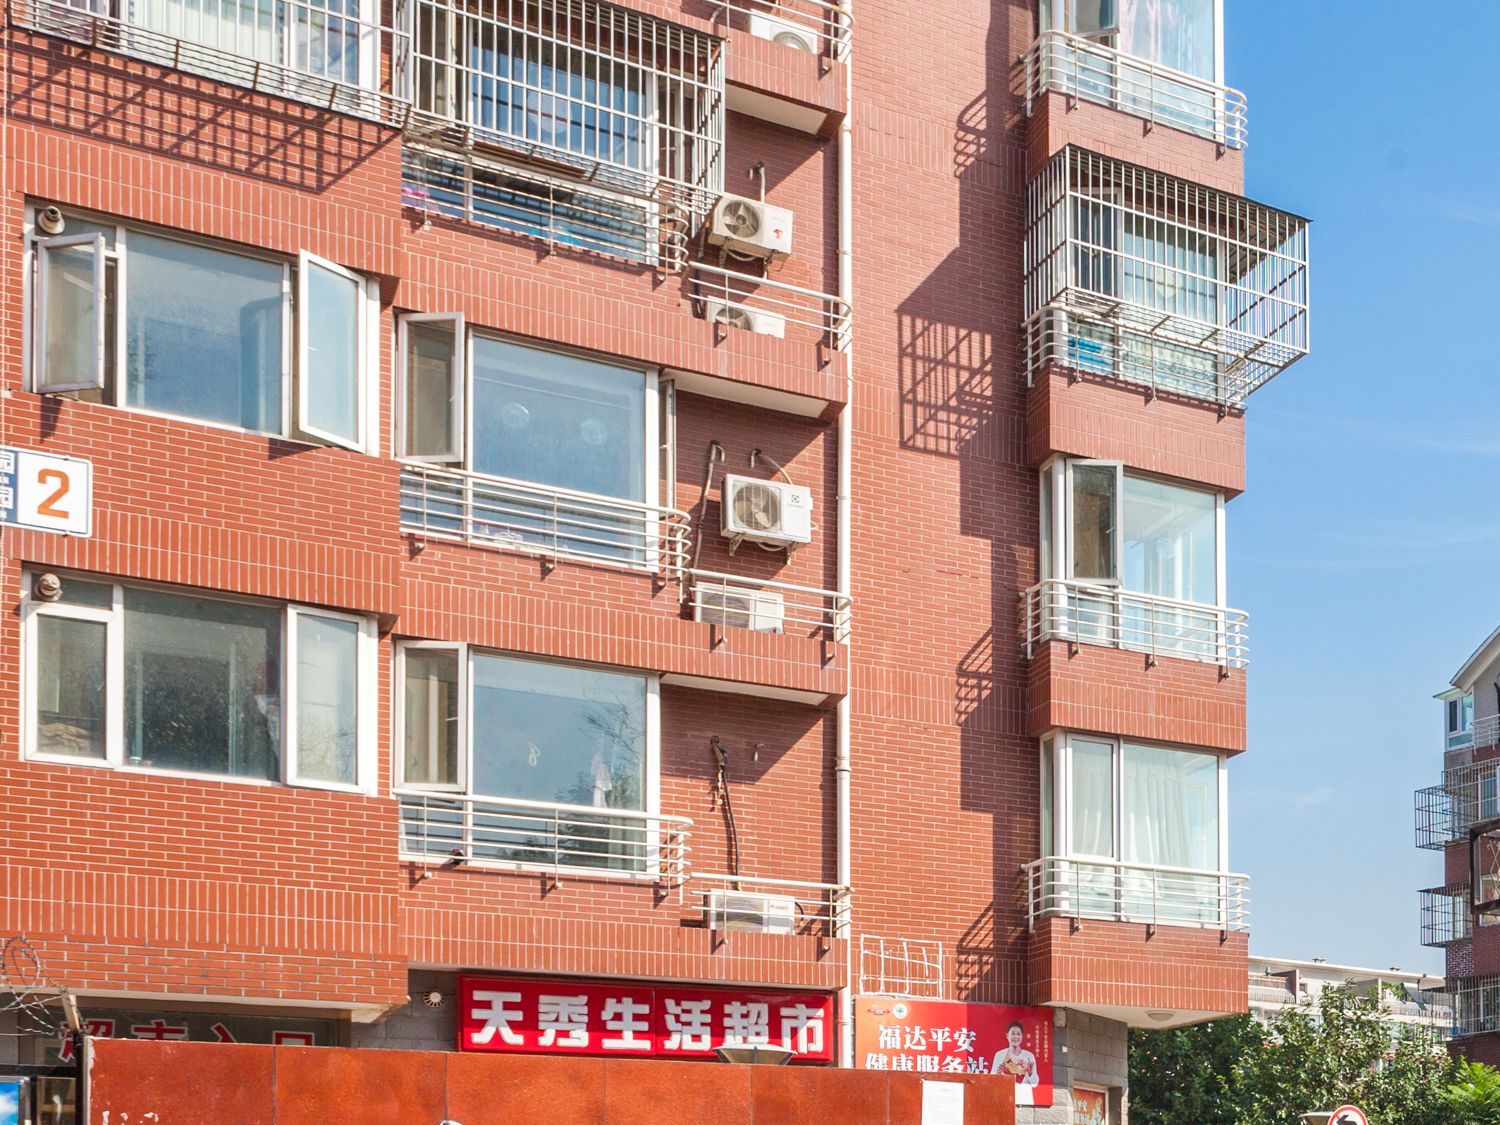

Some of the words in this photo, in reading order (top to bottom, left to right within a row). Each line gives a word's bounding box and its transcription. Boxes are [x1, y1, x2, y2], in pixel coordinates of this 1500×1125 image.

[38, 468, 69, 519] 2
[471, 989, 825, 1054] 天秀生活超市
[877, 1023, 976, 1053] 福达平安
